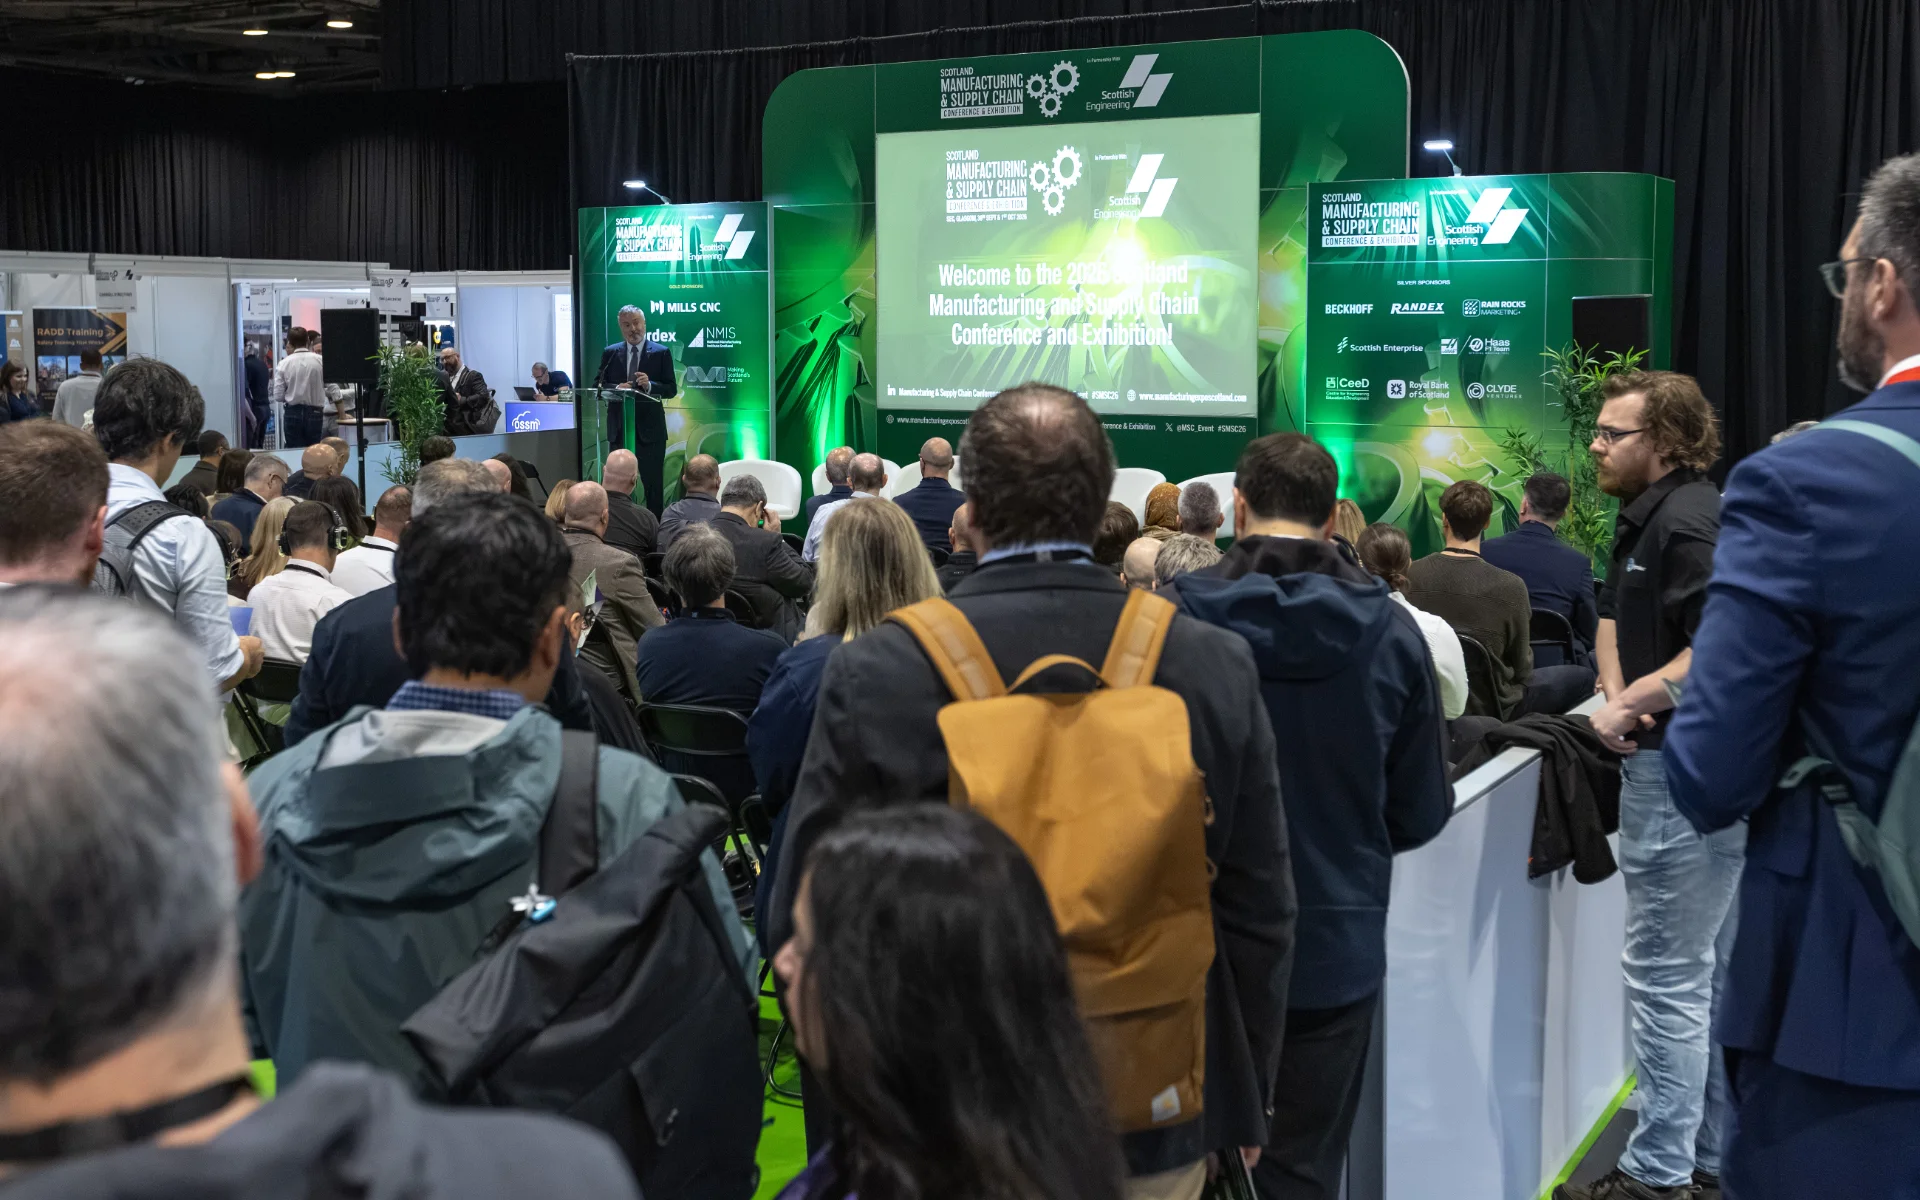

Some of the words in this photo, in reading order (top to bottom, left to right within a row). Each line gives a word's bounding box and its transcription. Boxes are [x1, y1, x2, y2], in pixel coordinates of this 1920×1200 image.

[940, 67, 973, 77] SCOTLAND
[940, 73, 1023, 93] MANUFACTURING
[941, 93, 948, 108] &
[950, 91, 989, 107] SUPPLY
[992, 89, 1023, 104] CHAIN
[1101, 89, 1135, 100] Scottish
[943, 108, 980, 118] CONFERENCE
[987, 105, 1021, 116] EXHIBITION
[1085, 100, 1131, 113] Engineering
[946, 149, 979, 161] SCOTLAND
[946, 160, 1028, 181] MANUFACTURING
[946, 181, 954, 199] &
[956, 180, 993, 198] SUPPLY
[996, 178, 1027, 197] CHAIN
[1109, 195, 1141, 206] Scottish
[1322, 193, 1362, 203] SCOTLAND
[949, 200, 984, 212] CONFERENCE
[1322, 201, 1420, 220] MANUFACTURING
[1093, 208, 1139, 221] Engineering
[615, 216, 643, 226] SCOTLAND
[1322, 221, 1330, 235] &
[1333, 219, 1379, 235] SUPPLY
[1382, 217, 1418, 234] CHAIN
[616, 224, 683, 239] MANUFACTURING
[1445, 224, 1484, 235] Scottish
[616, 240, 623, 252] &
[624, 238, 654, 252] SUPPLY
[657, 237, 683, 252] CHAIN
[1325, 236, 1368, 246] CONFERENCE
[1369, 237, 1374, 245] &
[1376, 235, 1417, 245] EXHIBITION
[1427, 235, 1478, 248] Engineering
[700, 243, 726, 252] Scottish
[688, 252, 723, 262] Engineering
[939, 263, 1011, 286] Welcome
[1015, 263, 1032, 286] to
[1036, 262, 1062, 286] the
[667, 302, 698, 313] MILLS
[699, 302, 721, 313] CNC
[929, 293, 1045, 320] Manufacturing
[1050, 293, 1080, 316] and
[1086, 292, 1145, 320] Supply
[1151, 291, 1199, 316] Chain
[1325, 303, 1374, 315] BECKHOFF
[1390, 302, 1445, 315] RANDEX
[1481, 301, 1501, 309] RAIN
[1501, 300, 1527, 309] ROCKS
[37, 327, 65, 337] RADD
[66, 327, 104, 338] Training
[646, 328, 677, 342] rdex
[706, 326, 736, 339] NMIS
[951, 322, 1042, 346] Conference
[1047, 322, 1078, 346] and
[1083, 321, 1174, 346] Exhibition!
[1484, 337, 1511, 347] Haas
[1349, 344, 1382, 353] Scottish
[1383, 344, 1424, 354] Enterprise
[1339, 378, 1370, 388] CeeD
[1409, 380, 1430, 390] Royal
[1430, 380, 1450, 390] Bank
[1486, 384, 1517, 394] CLYDE
[898, 387, 935, 398] Manufacturing
[935, 388, 940, 397] &
[940, 388, 958, 399] Supply
[958, 388, 973, 398] Chain
[1091, 390, 1120, 400] #SMSC26
[1409, 390, 1418, 399] of
[1418, 391, 1450, 400] Scotland
[514, 419, 539, 431] ossm
[1123, 422, 1129, 430] &
[1128, 422, 1156, 431] Exhibition
[1176, 423, 1214, 434] @MSC_Event
[1217, 424, 1248, 433] #SMSC26
